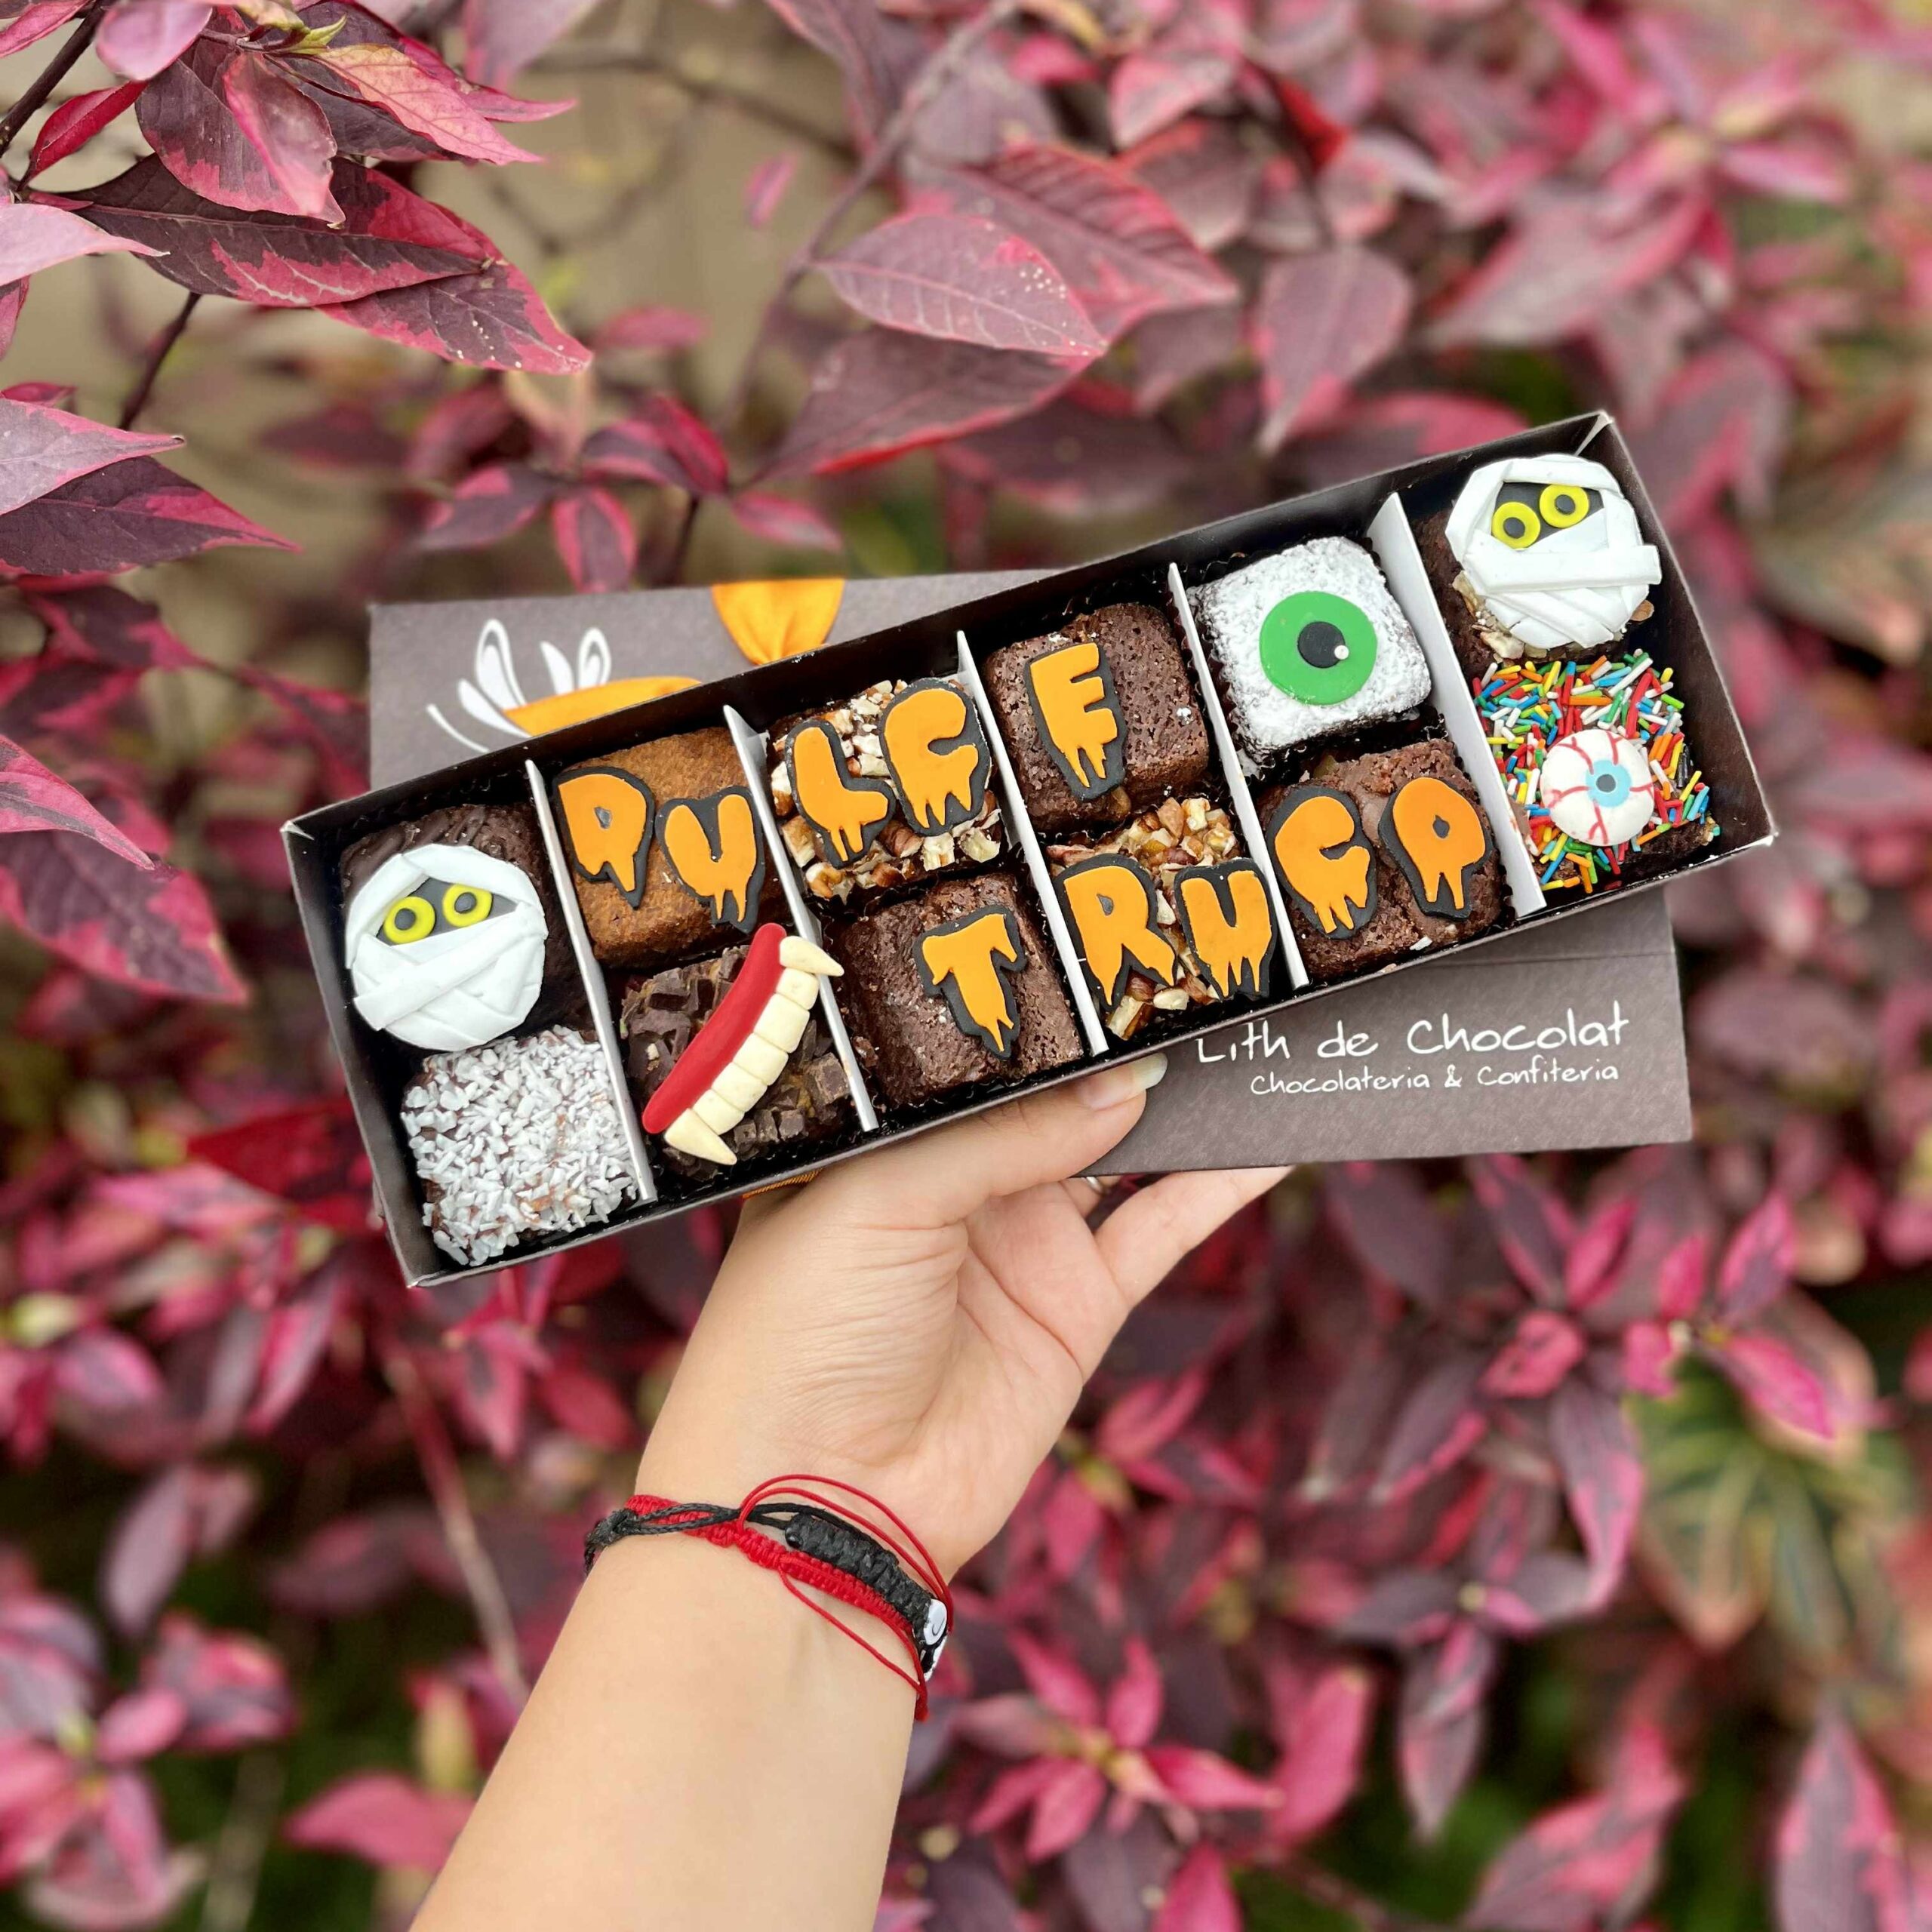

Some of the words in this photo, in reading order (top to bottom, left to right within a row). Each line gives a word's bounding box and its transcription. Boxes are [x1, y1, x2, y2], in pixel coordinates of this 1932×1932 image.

[1317, 1020, 1379, 1058] de
[1407, 1000, 1629, 1054] Chocolat
[1250, 1066, 1430, 1095] Chocolateria
[1444, 1064, 1462, 1088] &
[1478, 1054, 1619, 1086] Confiteria
